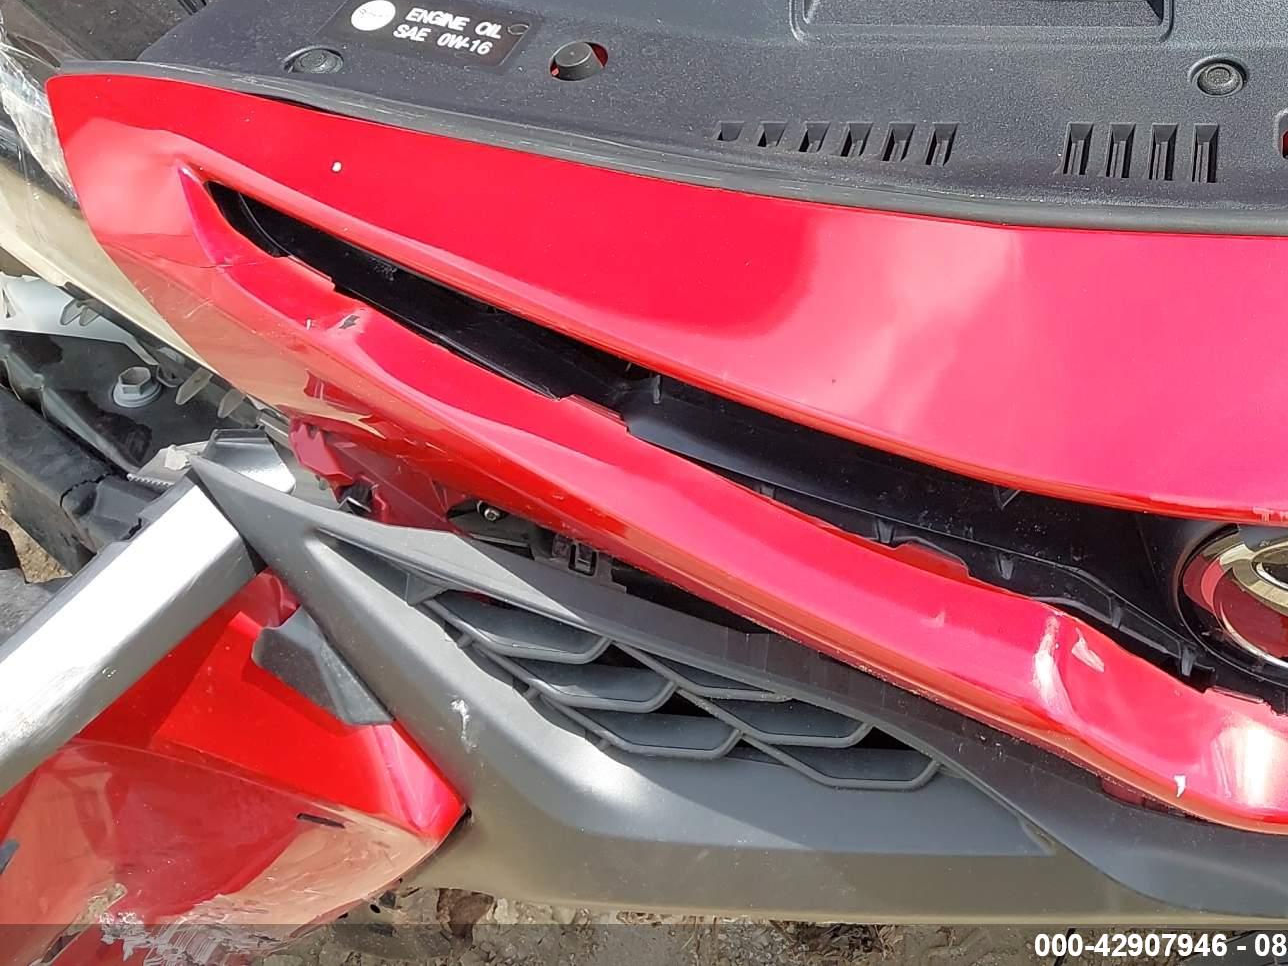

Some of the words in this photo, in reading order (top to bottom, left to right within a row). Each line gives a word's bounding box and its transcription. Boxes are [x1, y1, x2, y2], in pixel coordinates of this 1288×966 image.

[392, 23, 432, 43] SAE
[436, 32, 494, 56] 0W-16
[405, 7, 471, 32] ENGINE
[474, 20, 503, 40] OIL
